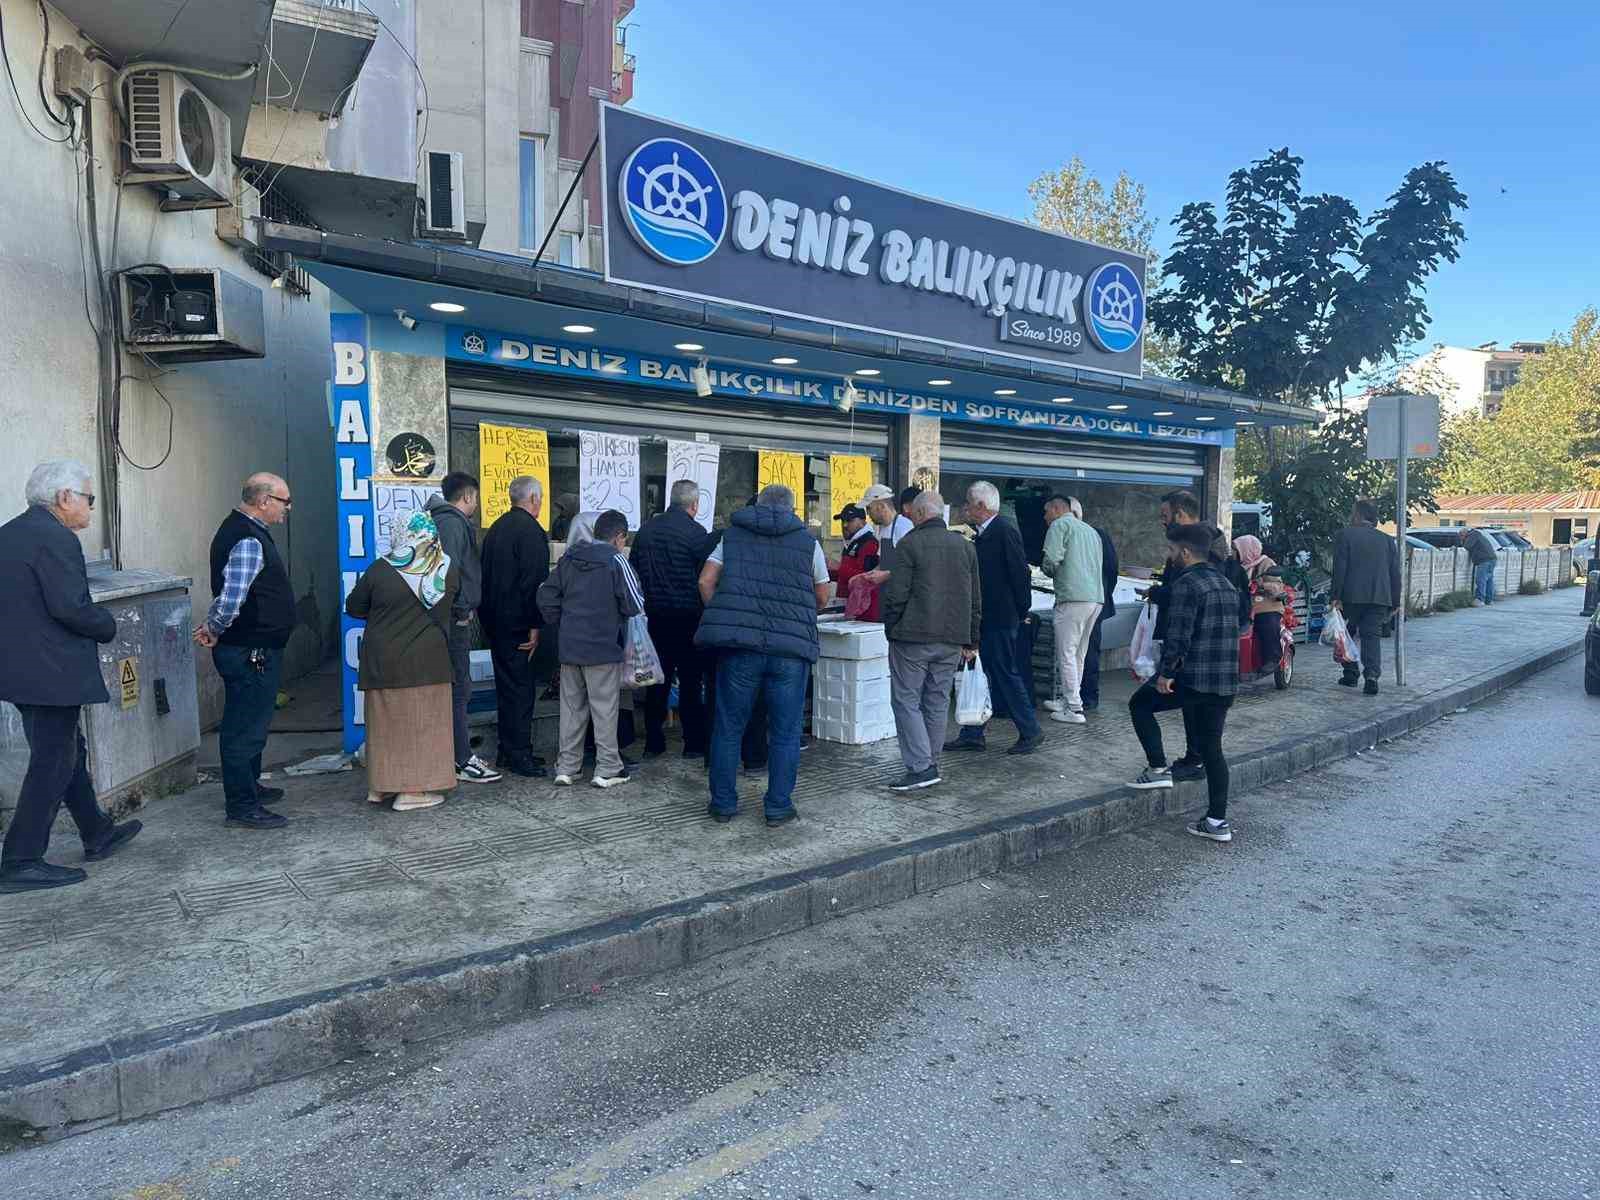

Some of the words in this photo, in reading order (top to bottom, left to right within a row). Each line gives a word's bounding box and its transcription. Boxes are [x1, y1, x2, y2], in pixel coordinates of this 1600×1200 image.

[732, 190, 874, 277] DENİZ
[880, 229, 1083, 324] BALIKÇILIK
[1010, 320, 1046, 341] Since
[1047, 326, 1081, 347] 1989
[501, 340, 627, 374] DENİZ
[966, 403, 1087, 428] SOFRANIZA
[376, 487, 443, 511] DEN
